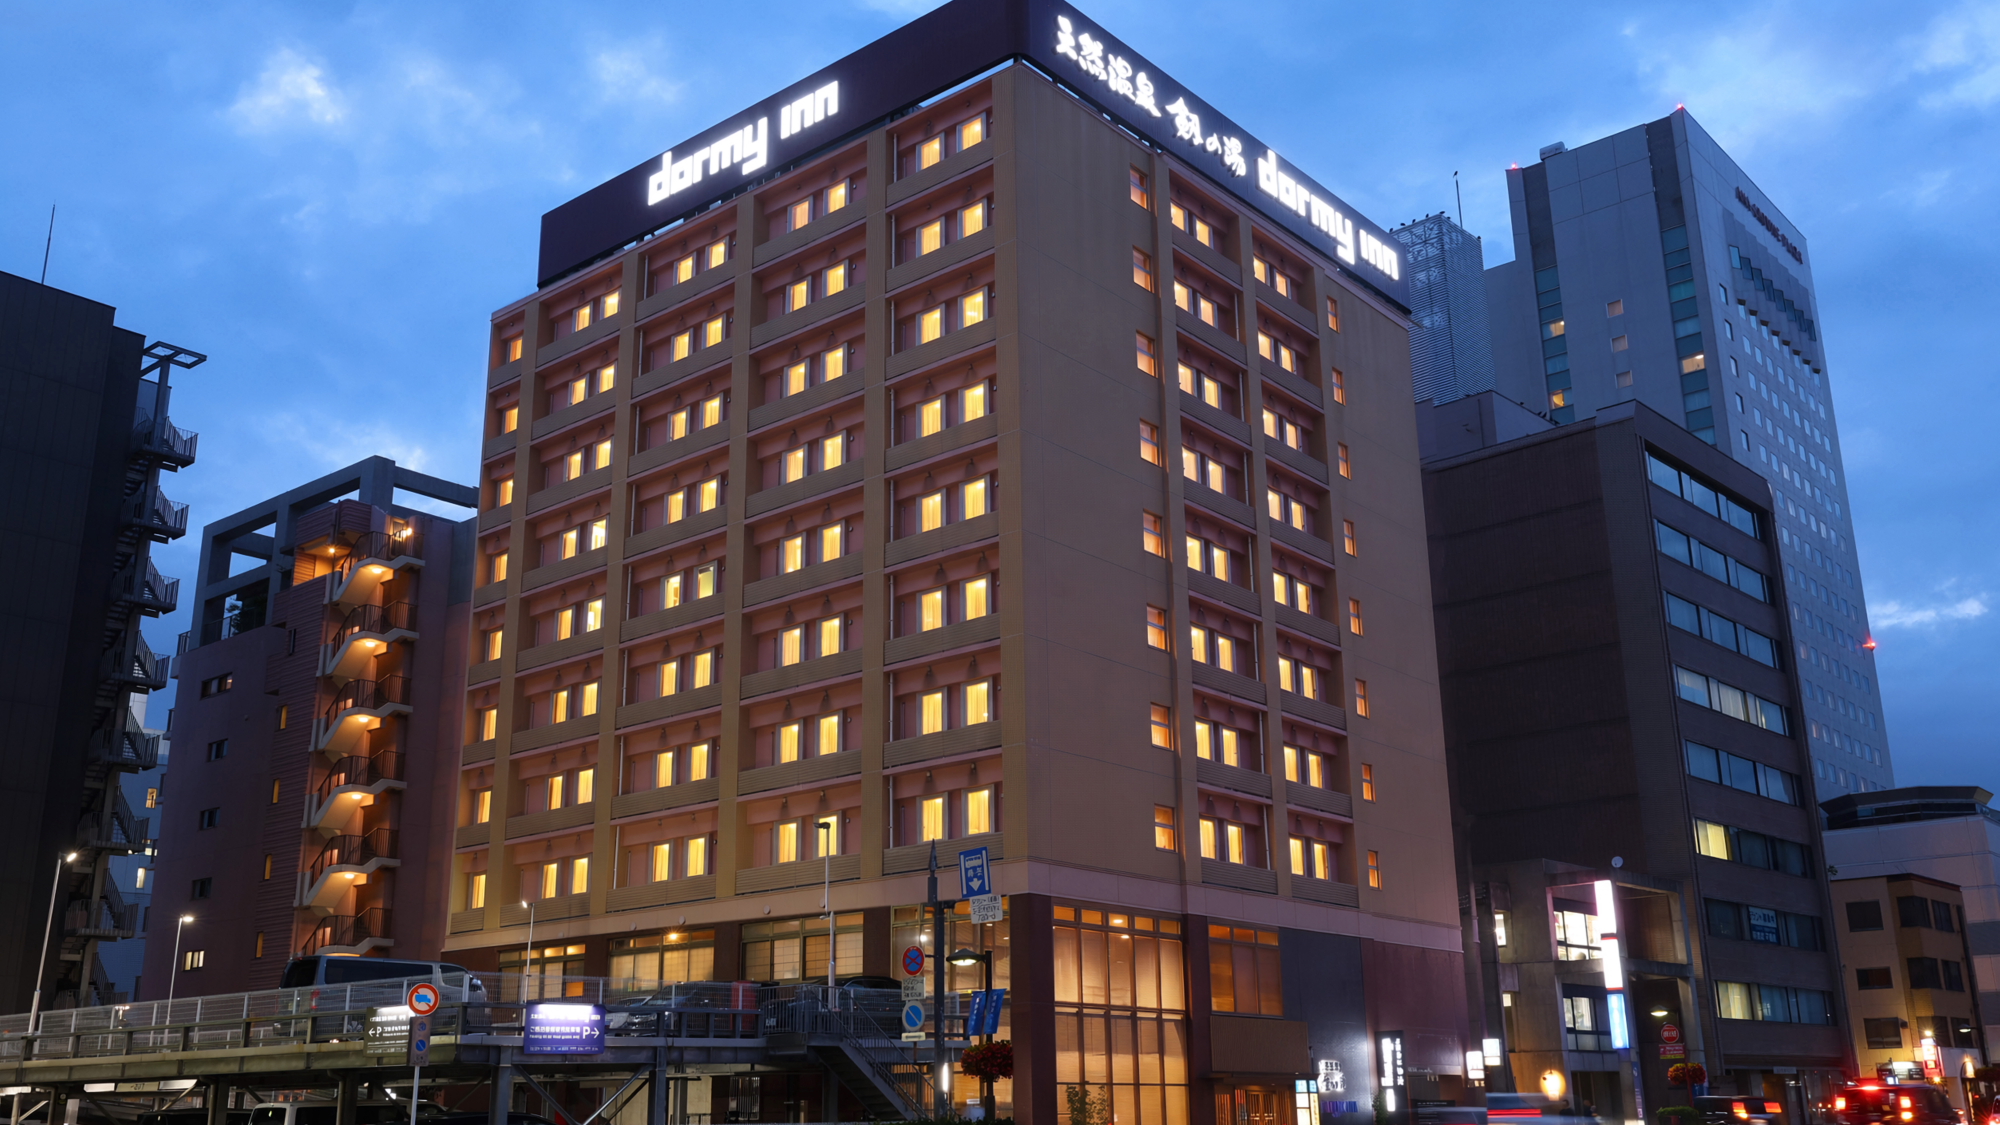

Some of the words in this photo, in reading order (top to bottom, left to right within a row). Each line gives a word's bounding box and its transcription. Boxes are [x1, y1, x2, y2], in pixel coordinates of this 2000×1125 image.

[1056, 15, 1162, 118] 天然温泉
[648, 117, 768, 206] dormy
[780, 80, 839, 139] inn
[1258, 149, 1355, 265] dormy
[1359, 229, 1399, 281] inn
[376, 1026, 382, 1037] P
[583, 1026, 591, 1039] P
